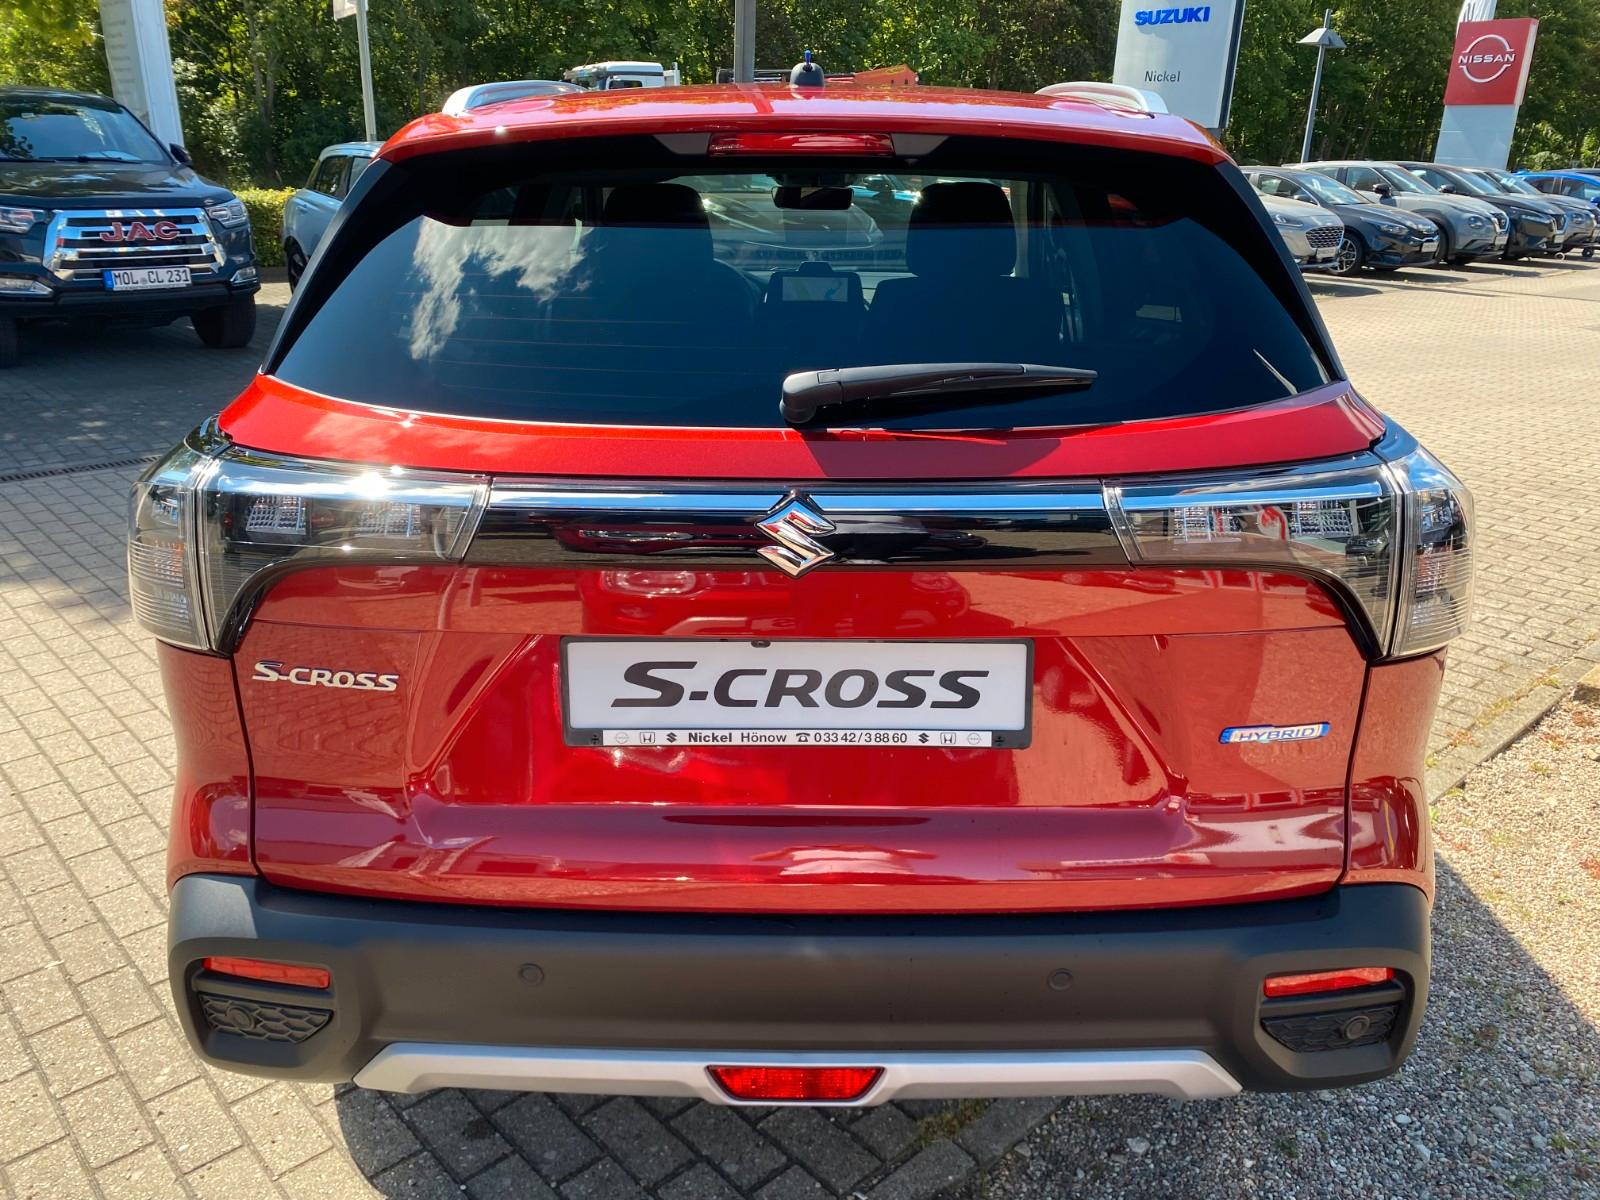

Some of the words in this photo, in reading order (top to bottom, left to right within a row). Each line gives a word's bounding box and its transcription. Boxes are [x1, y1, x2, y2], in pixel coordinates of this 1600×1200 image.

[1135, 6, 1210, 26] SUZUKI
[1458, 54, 1515, 63] NISSAN
[1144, 71, 1181, 82] Nickel
[101, 221, 180, 241] JAC
[113, 272, 139, 285] MOL
[147, 271, 164, 283] CL
[166, 270, 190, 283] 231
[252, 660, 399, 692] S-CROSS
[610, 661, 990, 709] S-CROSS
[688, 732, 732, 743] Nickel
[740, 732, 787, 743] Hönow
[1239, 727, 1316, 741] HYBRID
